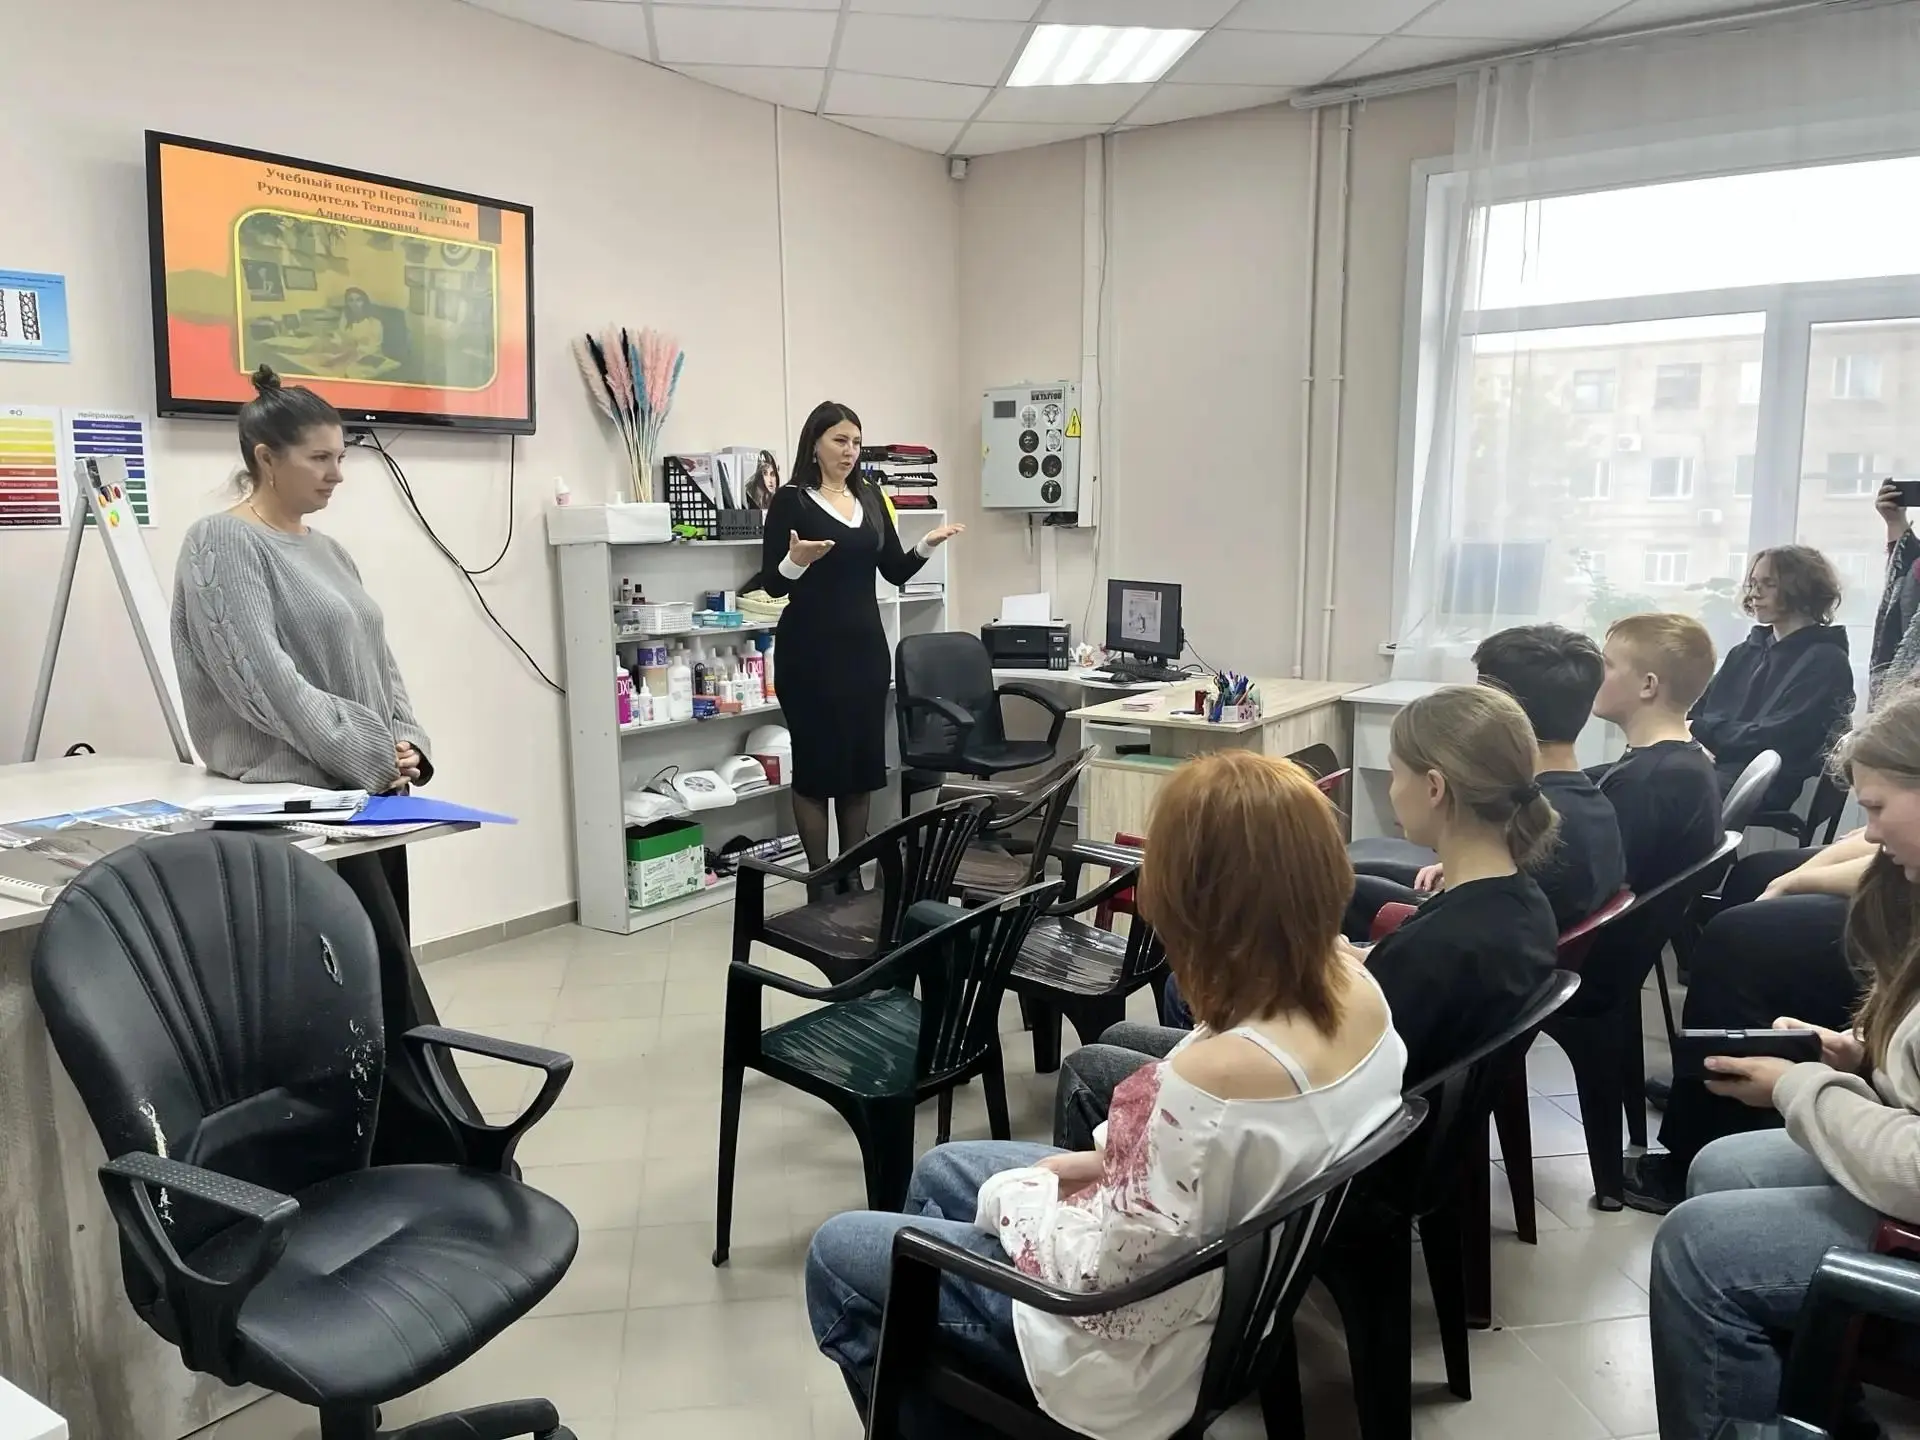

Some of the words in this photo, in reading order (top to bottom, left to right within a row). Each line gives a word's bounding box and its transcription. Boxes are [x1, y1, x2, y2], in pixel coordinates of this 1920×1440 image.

[257, 181, 359, 208] Руководитель
[361, 201, 416, 219] Теплова
[418, 211, 470, 230] Наталья
[266, 167, 332, 189] Учебный
[335, 183, 376, 199] центр
[379, 190, 462, 214] Перспектива
[315, 207, 419, 233] Александровна
